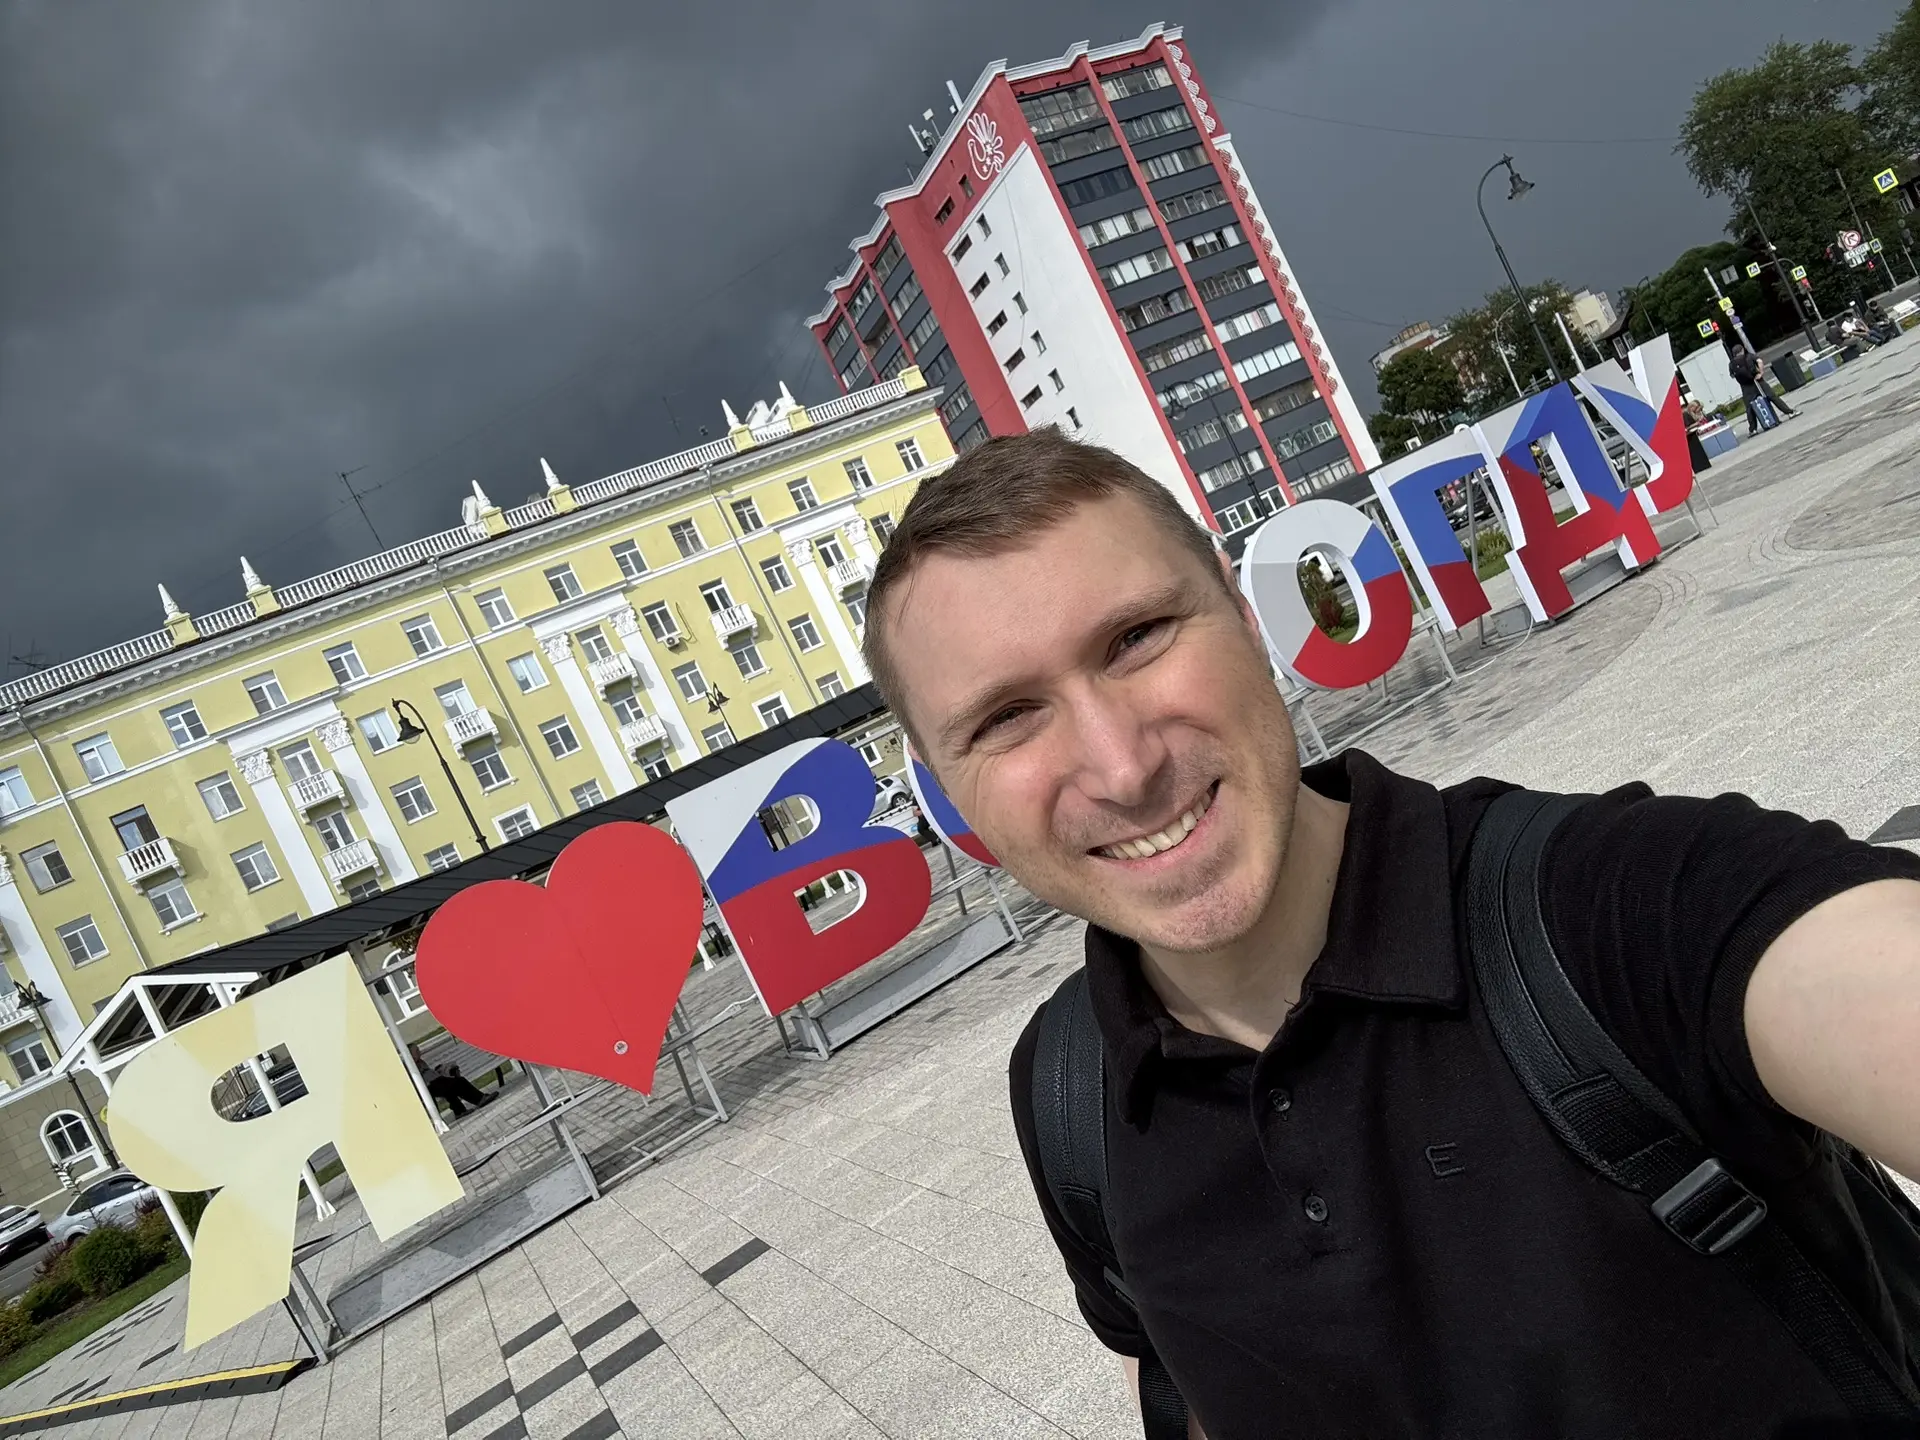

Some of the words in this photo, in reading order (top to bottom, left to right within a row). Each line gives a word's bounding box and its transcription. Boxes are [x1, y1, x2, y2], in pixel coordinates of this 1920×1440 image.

[107, 950, 466, 1354] Я
[665, 333, 1694, 1018] ВОГДУ
[1425, 1141, 1466, 1177] E
